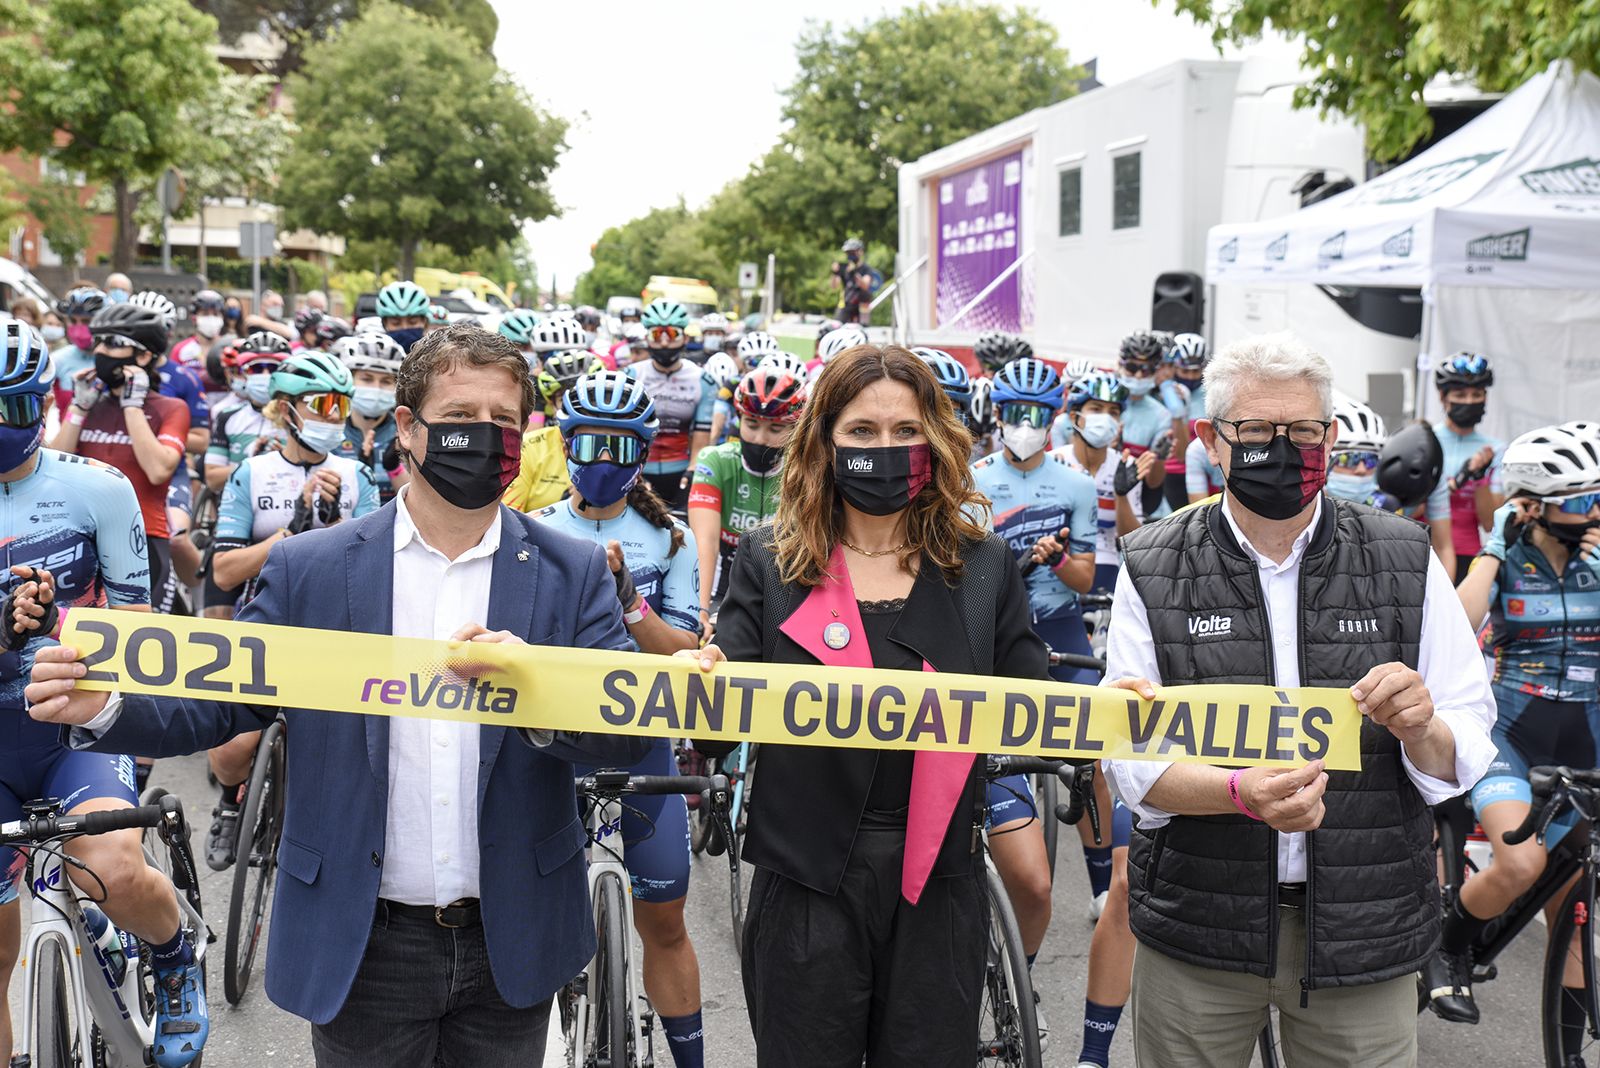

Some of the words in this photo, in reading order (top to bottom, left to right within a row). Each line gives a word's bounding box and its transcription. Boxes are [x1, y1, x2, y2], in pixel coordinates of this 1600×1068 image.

[1188, 614, 1232, 635] Volta
[1338, 618, 1379, 633] GOBIK
[75, 620, 278, 697] 2021
[360, 672, 519, 714] reVolta
[599, 669, 768, 734] SANT
[782, 680, 987, 745] CUGAT
[1000, 692, 1104, 752] DEL
[1126, 690, 1333, 762] VALLÈS
[1084, 1018, 1116, 1033] eagle
